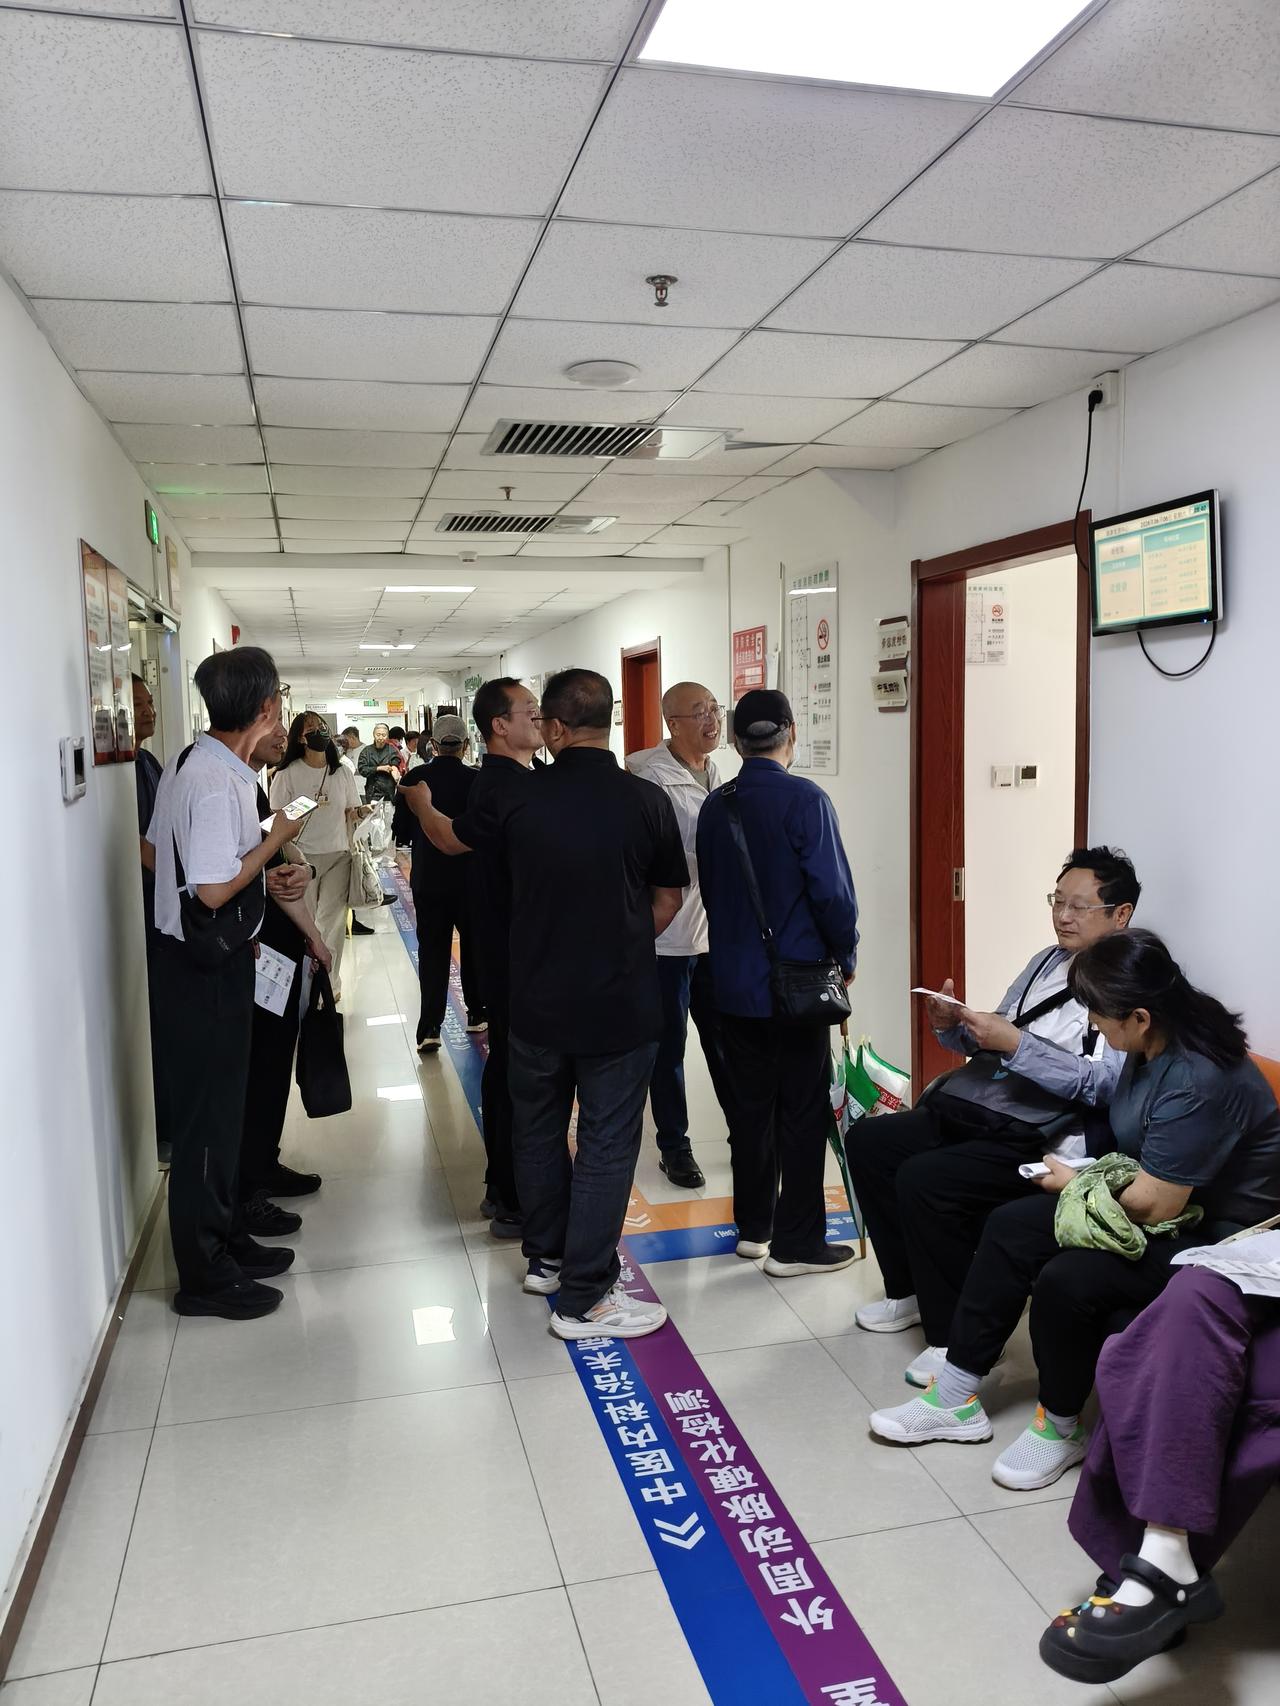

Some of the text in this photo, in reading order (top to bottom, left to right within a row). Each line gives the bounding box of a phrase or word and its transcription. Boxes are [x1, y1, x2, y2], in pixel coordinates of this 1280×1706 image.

[663, 1389, 834, 1635] 外周动脉硬化检测
